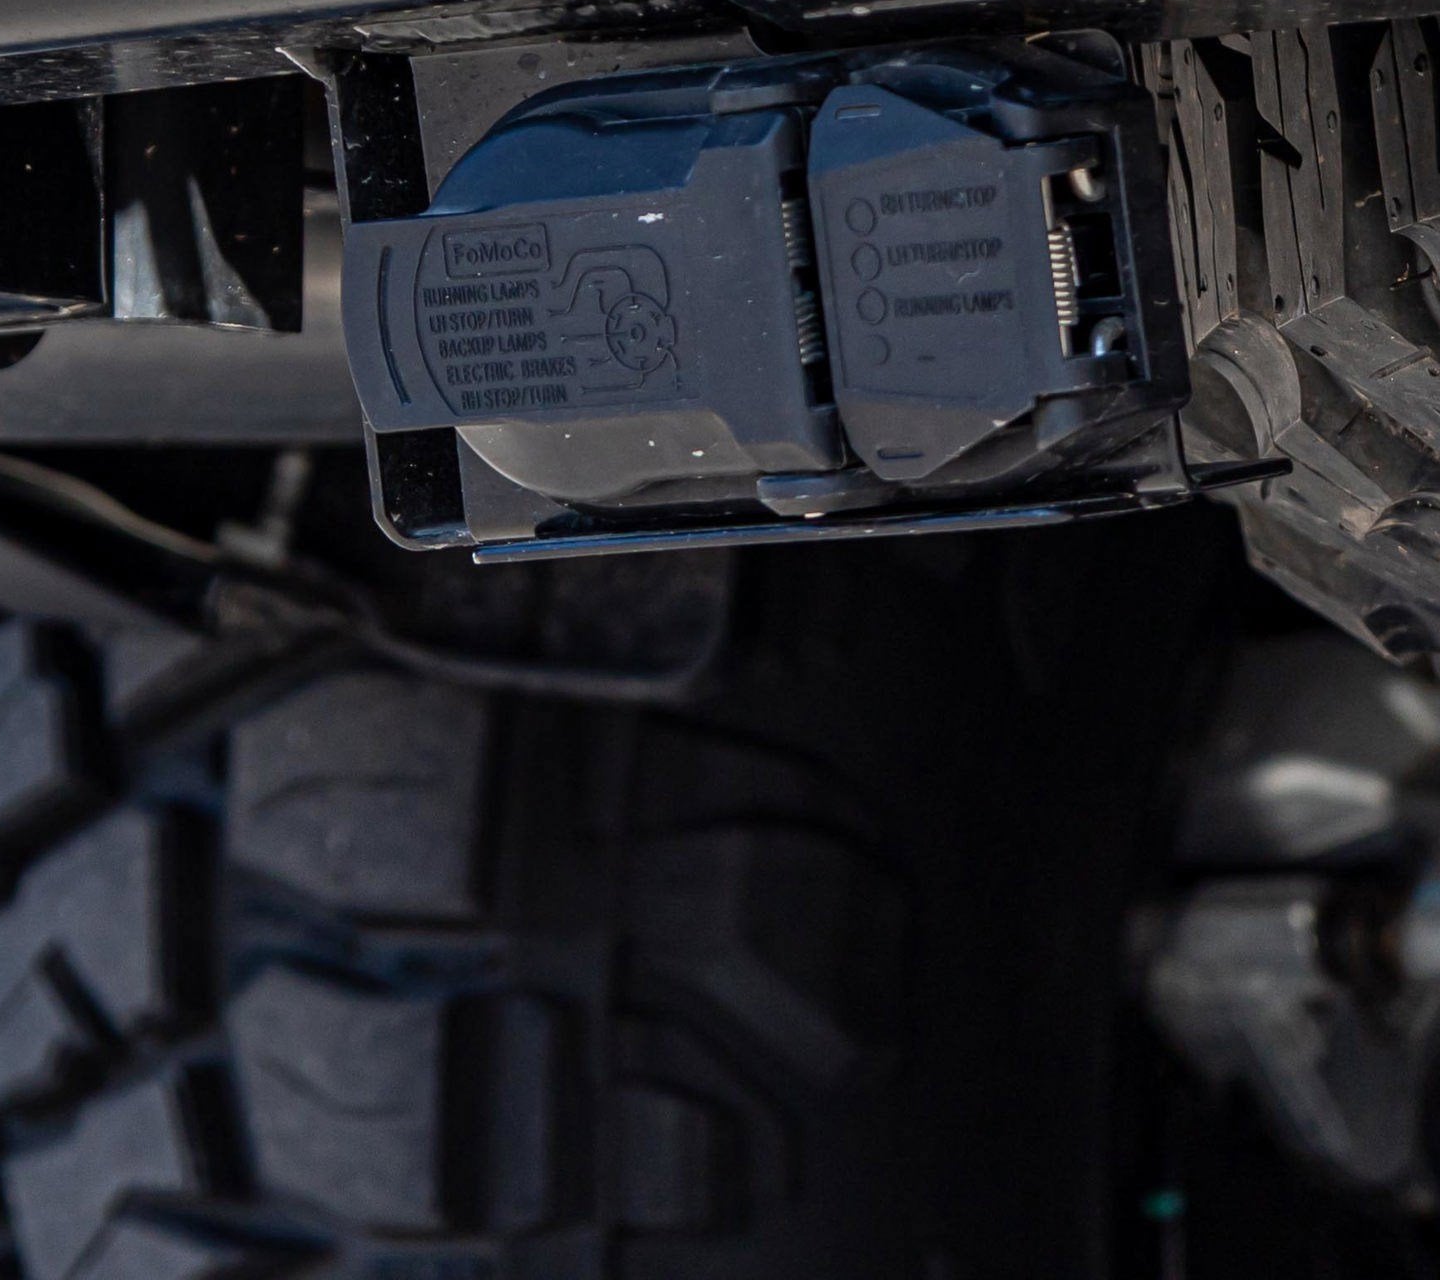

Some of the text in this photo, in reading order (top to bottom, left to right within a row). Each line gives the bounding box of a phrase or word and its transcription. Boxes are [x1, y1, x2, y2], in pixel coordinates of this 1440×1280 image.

[452, 237, 542, 266] FoMoCo
[423, 278, 541, 308] RUNNING LAMPS
[894, 289, 1014, 319] RUNNING LAMPS
[429, 307, 533, 334] LH STOP/TURN
[438, 330, 547, 359] BACKUP LAMPS
[446, 355, 578, 387] ELECTRIC BRAKES
[461, 383, 569, 411] RH STOP/TURN
